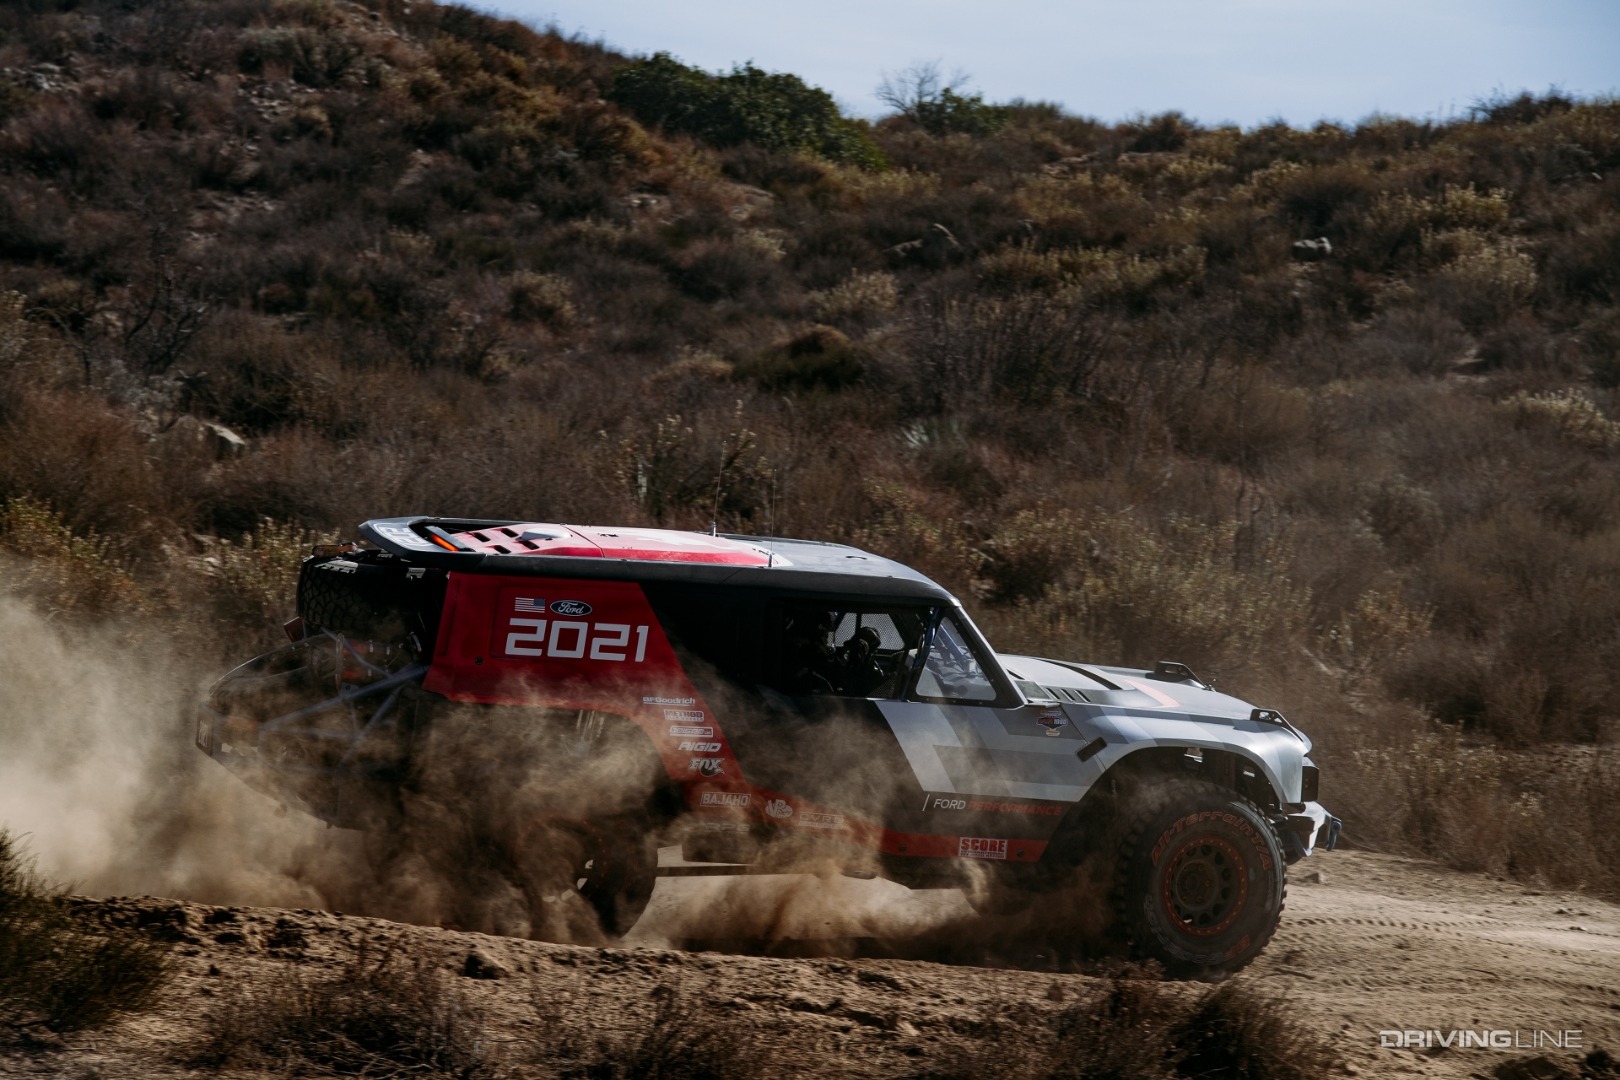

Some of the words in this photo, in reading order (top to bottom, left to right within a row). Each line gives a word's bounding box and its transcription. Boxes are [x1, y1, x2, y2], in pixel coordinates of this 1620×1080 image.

[557, 601, 585, 614] Ford
[504, 617, 649, 662] 2021
[678, 742, 722, 752] RIGID
[933, 798, 966, 810] FORD
[967, 800, 1063, 816] PERFORMANCE
[960, 838, 1006, 853] SCORE
